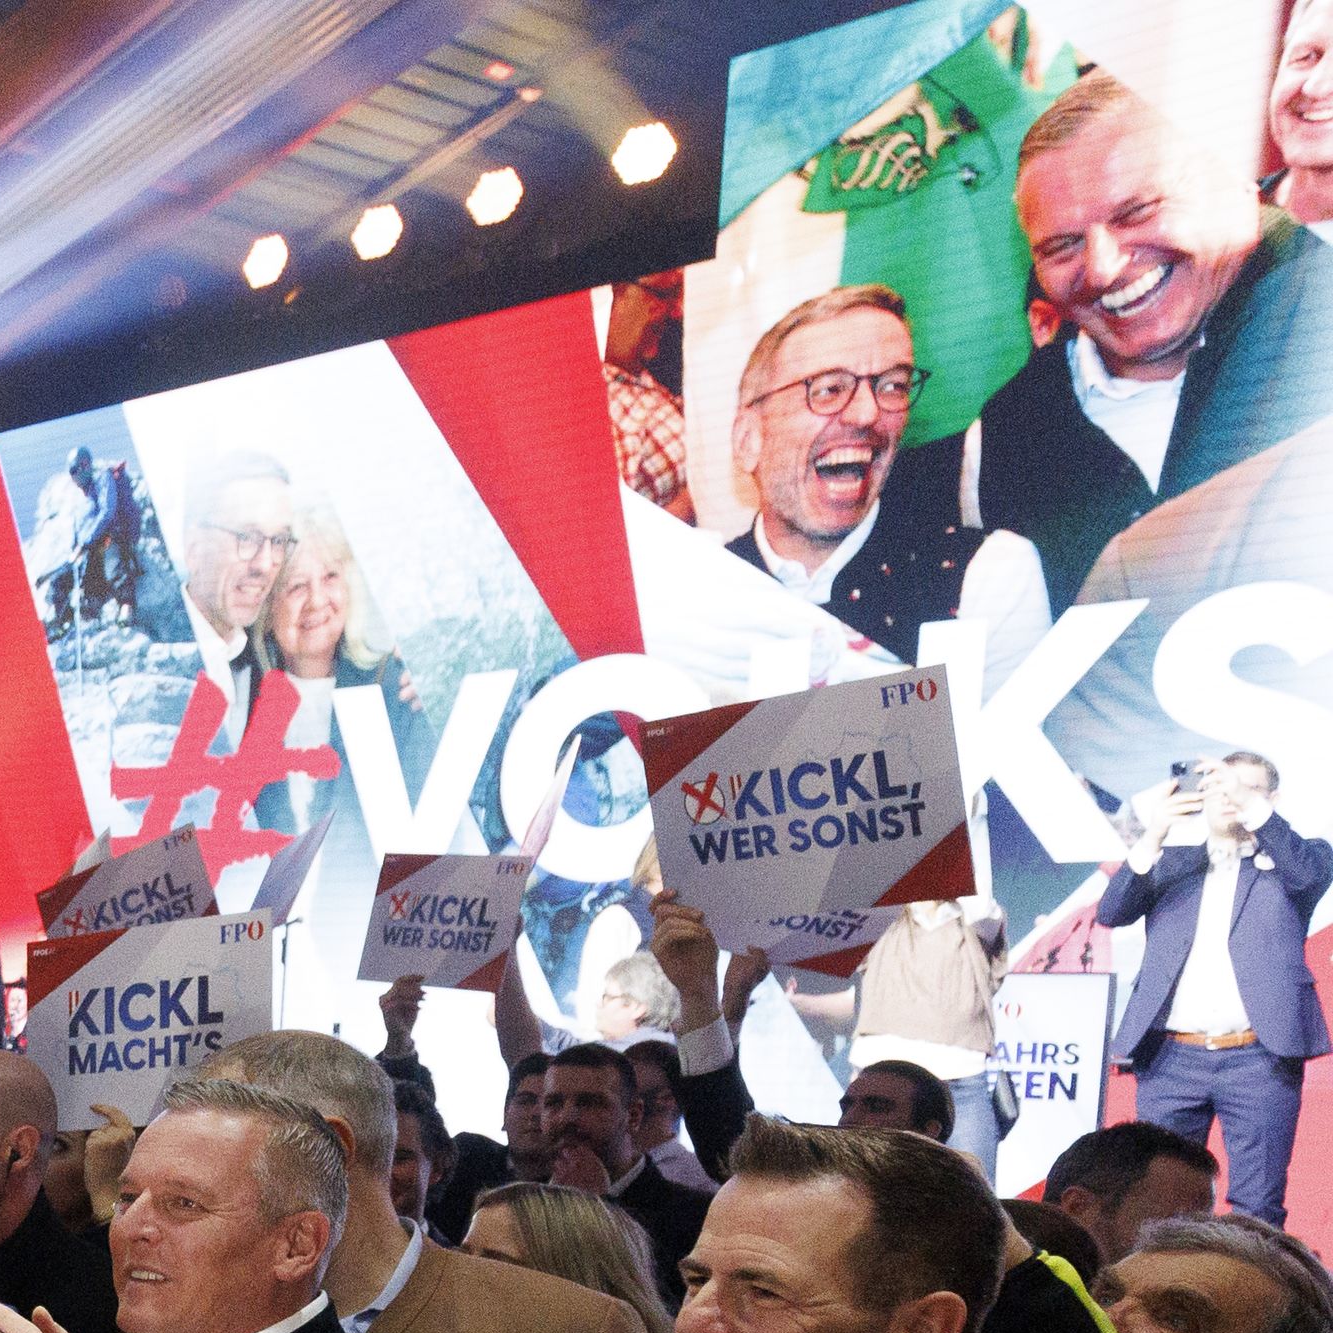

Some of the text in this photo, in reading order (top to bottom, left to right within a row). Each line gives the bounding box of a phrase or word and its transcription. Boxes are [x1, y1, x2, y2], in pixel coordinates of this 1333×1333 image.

[689, 801, 926, 866] WER SONST
[383, 924, 497, 953] WER SONST
[69, 975, 224, 1038] KICKL
[69, 1030, 224, 1076] MACHT'S
[994, 1041, 1080, 1065] AHRS
